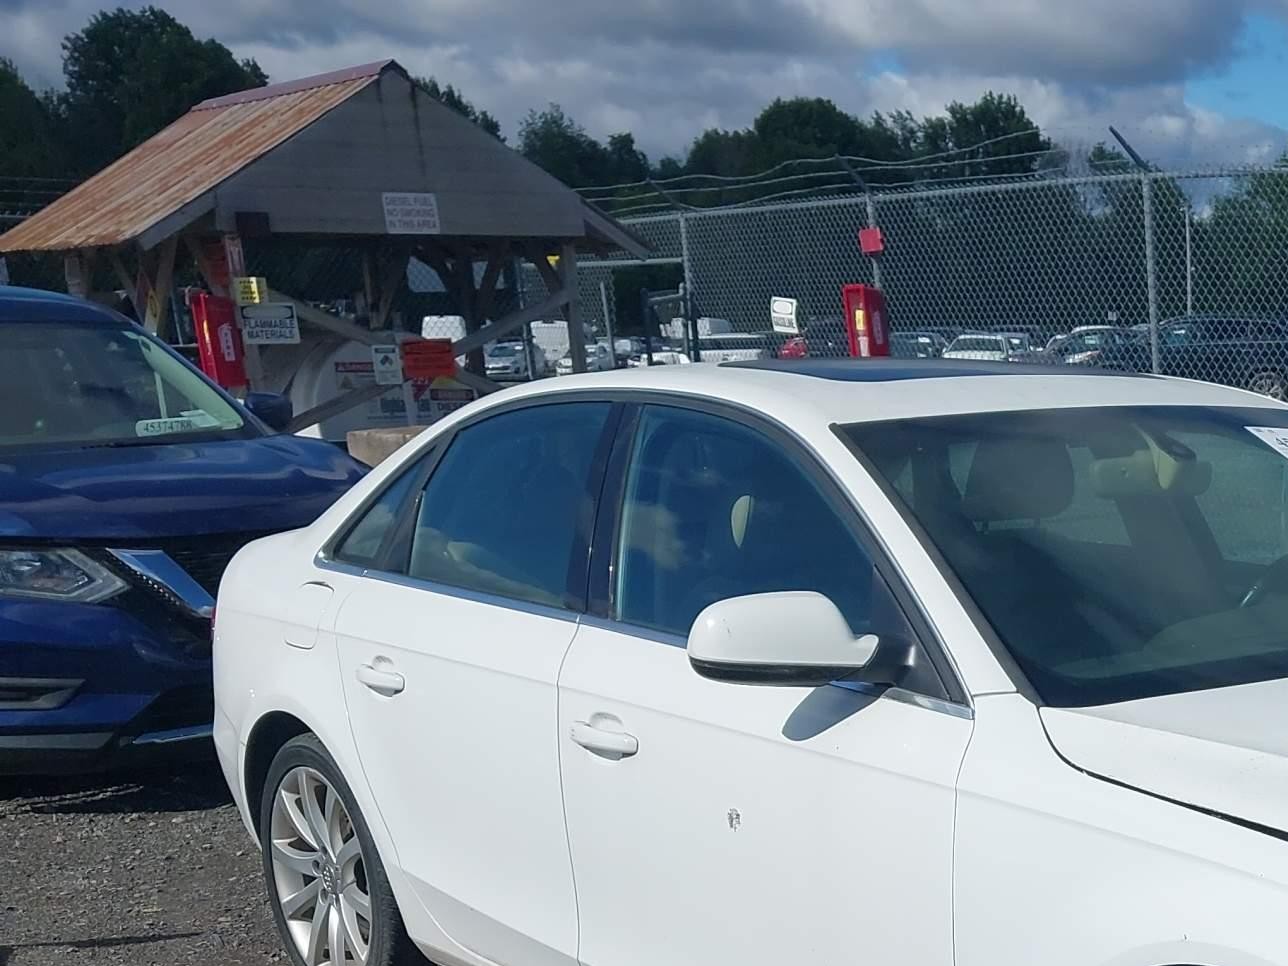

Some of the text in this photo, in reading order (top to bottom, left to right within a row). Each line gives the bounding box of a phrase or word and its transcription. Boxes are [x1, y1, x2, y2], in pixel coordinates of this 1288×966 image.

[386, 208, 435, 218] NO SMOKING
[244, 319, 296, 329] FLAMMABLE
[247, 329, 295, 339] MATERIALS
